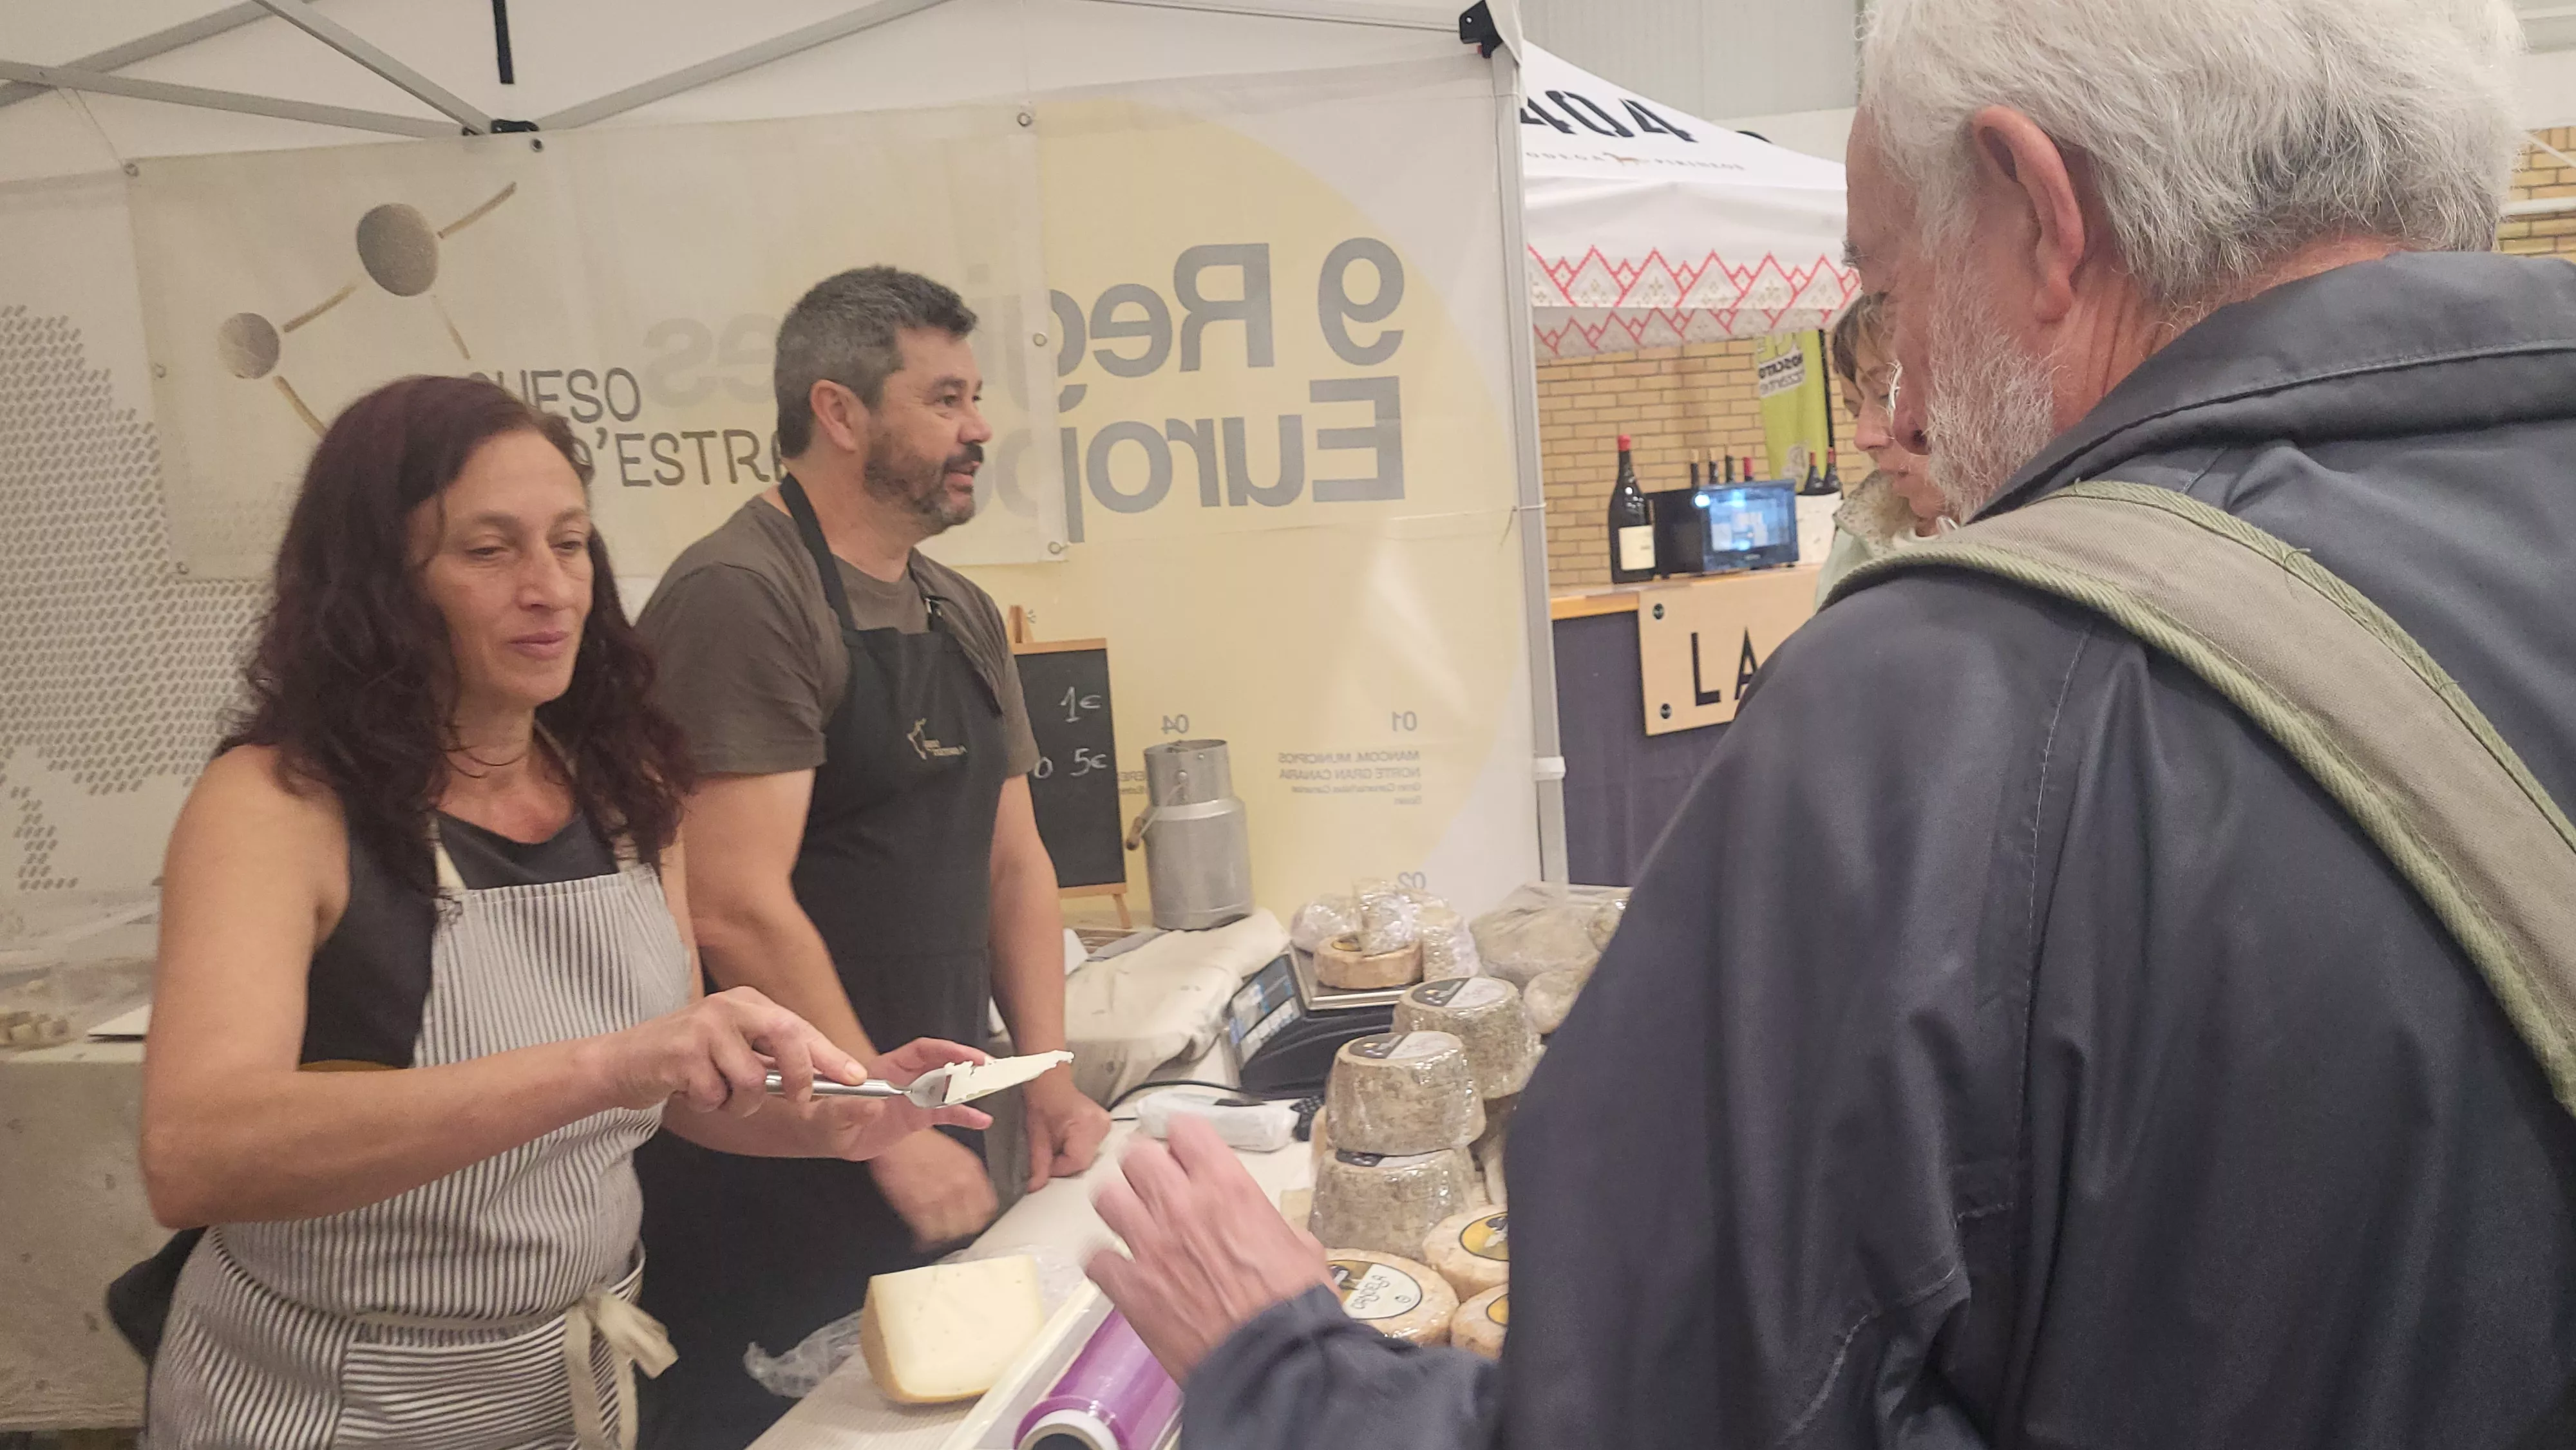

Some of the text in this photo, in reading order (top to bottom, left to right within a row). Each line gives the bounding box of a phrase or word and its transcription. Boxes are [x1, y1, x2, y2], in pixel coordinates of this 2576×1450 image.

[469, 368, 641, 424] ESO
[572, 427, 787, 487] 'ESTR
[1059, 686, 1102, 722] 1€
[1070, 748, 1108, 777] 5€
